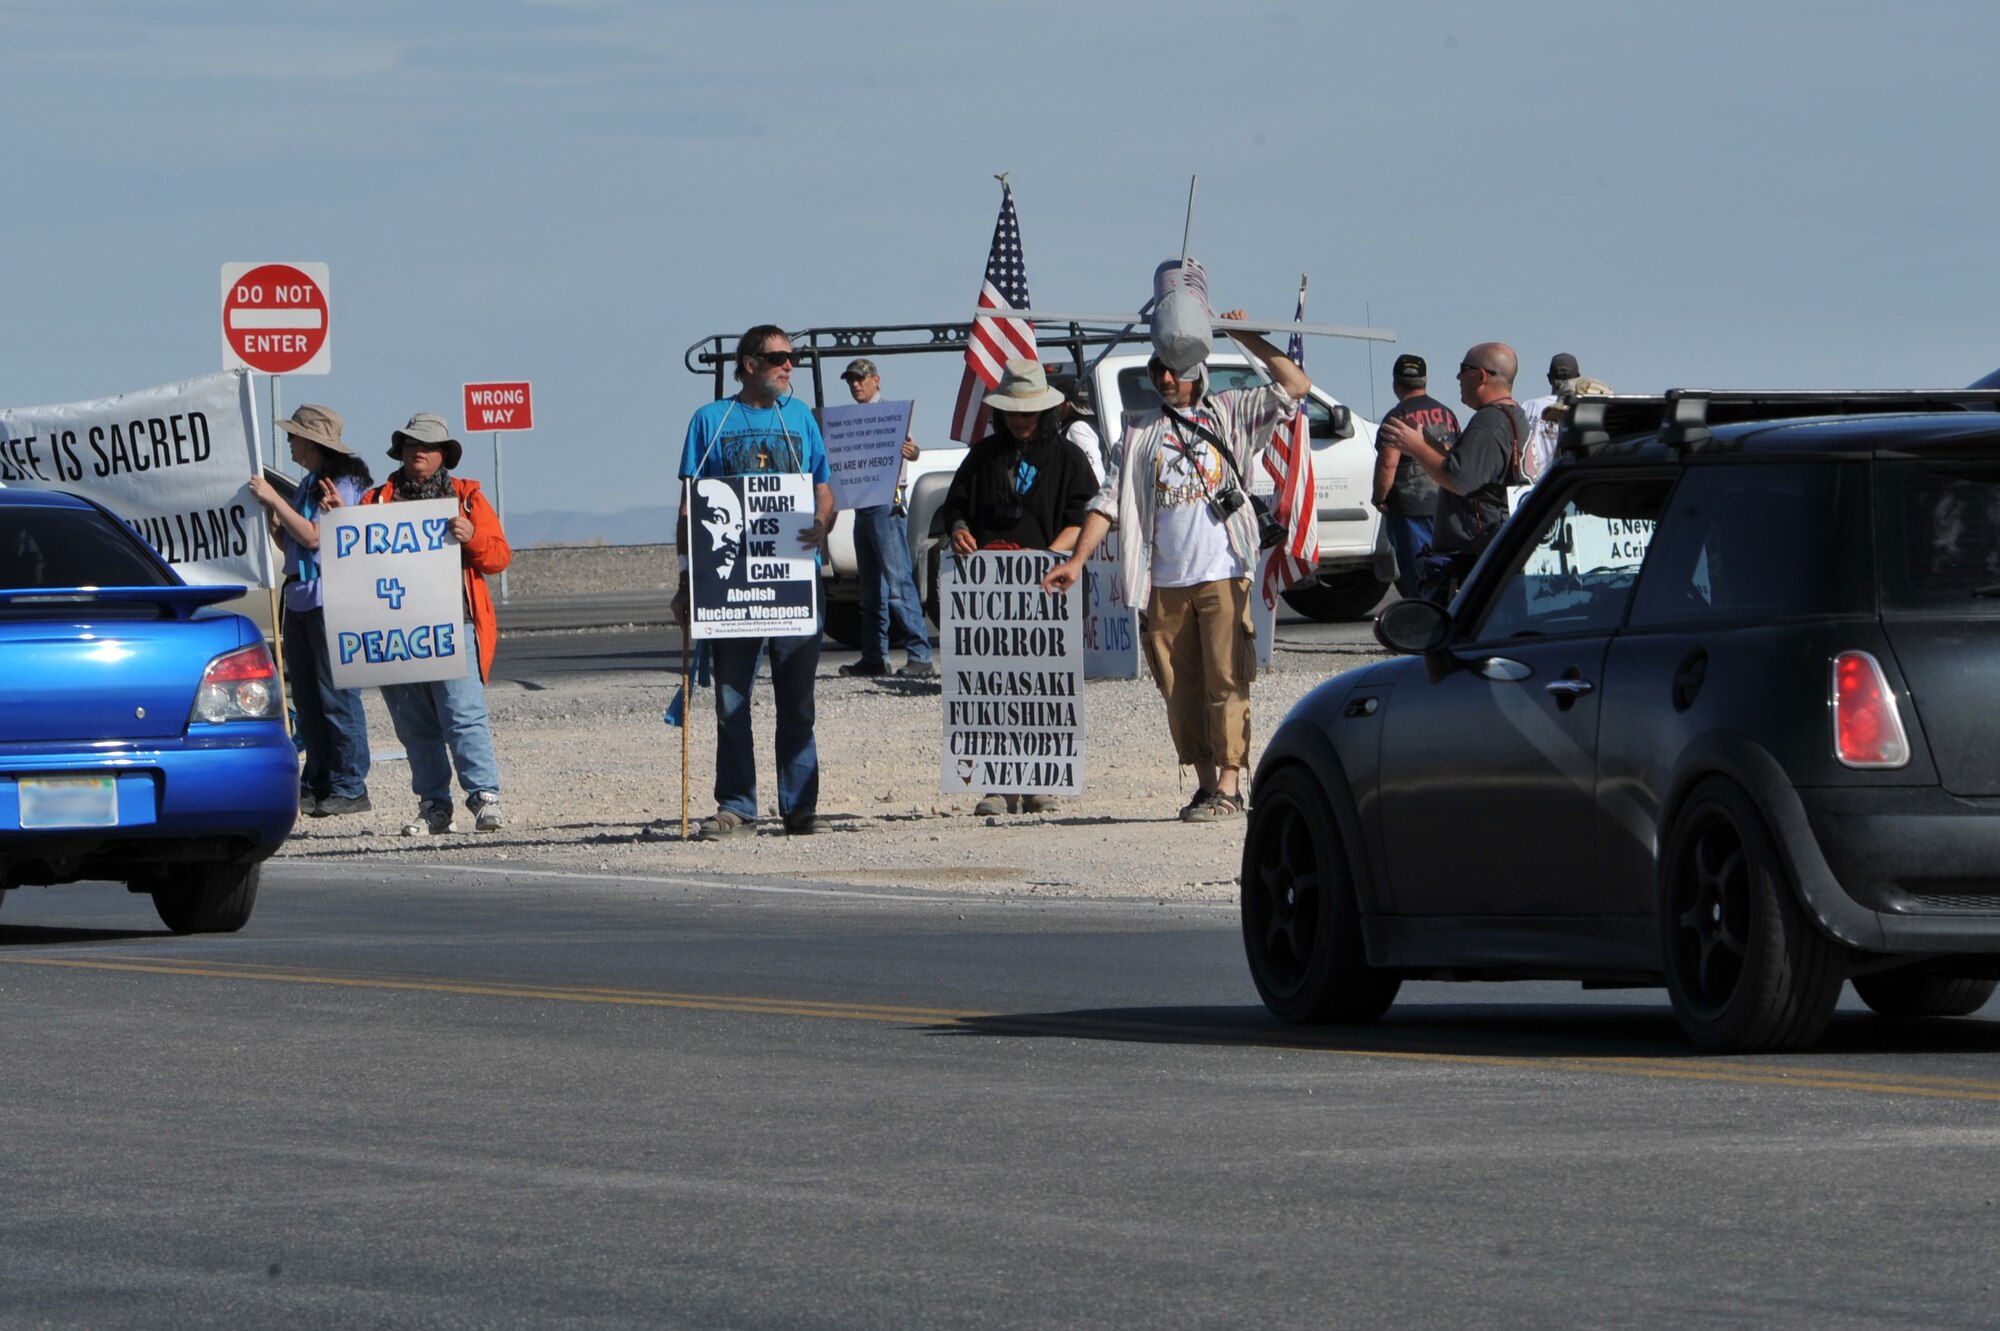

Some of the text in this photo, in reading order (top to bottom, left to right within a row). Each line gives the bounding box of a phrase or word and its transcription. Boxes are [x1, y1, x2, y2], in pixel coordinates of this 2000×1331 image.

[237, 285, 313, 303] DO NOT
[244, 335, 308, 353] ENTER
[471, 389, 524, 406] WRONG
[482, 409, 514, 424] WAY
[864, 416, 877, 424] YOUR
[877, 414, 902, 423] SACRIFICE
[873, 427, 896, 435] FREEDOM
[50, 430, 83, 482] IS
[88, 412, 211, 478] SACRED
[862, 442, 875, 450] YOUR
[875, 441, 895, 449] SERVICE
[843, 460, 857, 470] ARE
[857, 459, 868, 469] MY
[868, 456, 894, 468] HERO'S
[748, 476, 781, 492] END
[748, 495, 795, 513] WAR!
[749, 518, 780, 535] YES
[1621, 518, 1657, 534] Neve
[336, 517, 449, 558] PRAY
[749, 541, 776, 557] WE
[1611, 541, 1646, 559] A Cri
[750, 563, 790, 580] CAN!
[948, 555, 986, 585] NO
[376, 578, 405, 610] 4
[727, 587, 776, 602] Abolish
[697, 605, 810, 621] Nuclear Weapons
[950, 591, 1070, 621] NUCLEAR
[338, 623, 455, 665] PEACE
[954, 626, 1067, 657] HORROR
[957, 671, 1076, 697] NAGASAKI
[949, 701, 1078, 727] FUKUSHIMA
[950, 731, 1077, 757] CHERNOBYL
[982, 762, 1075, 787] NEVADA
